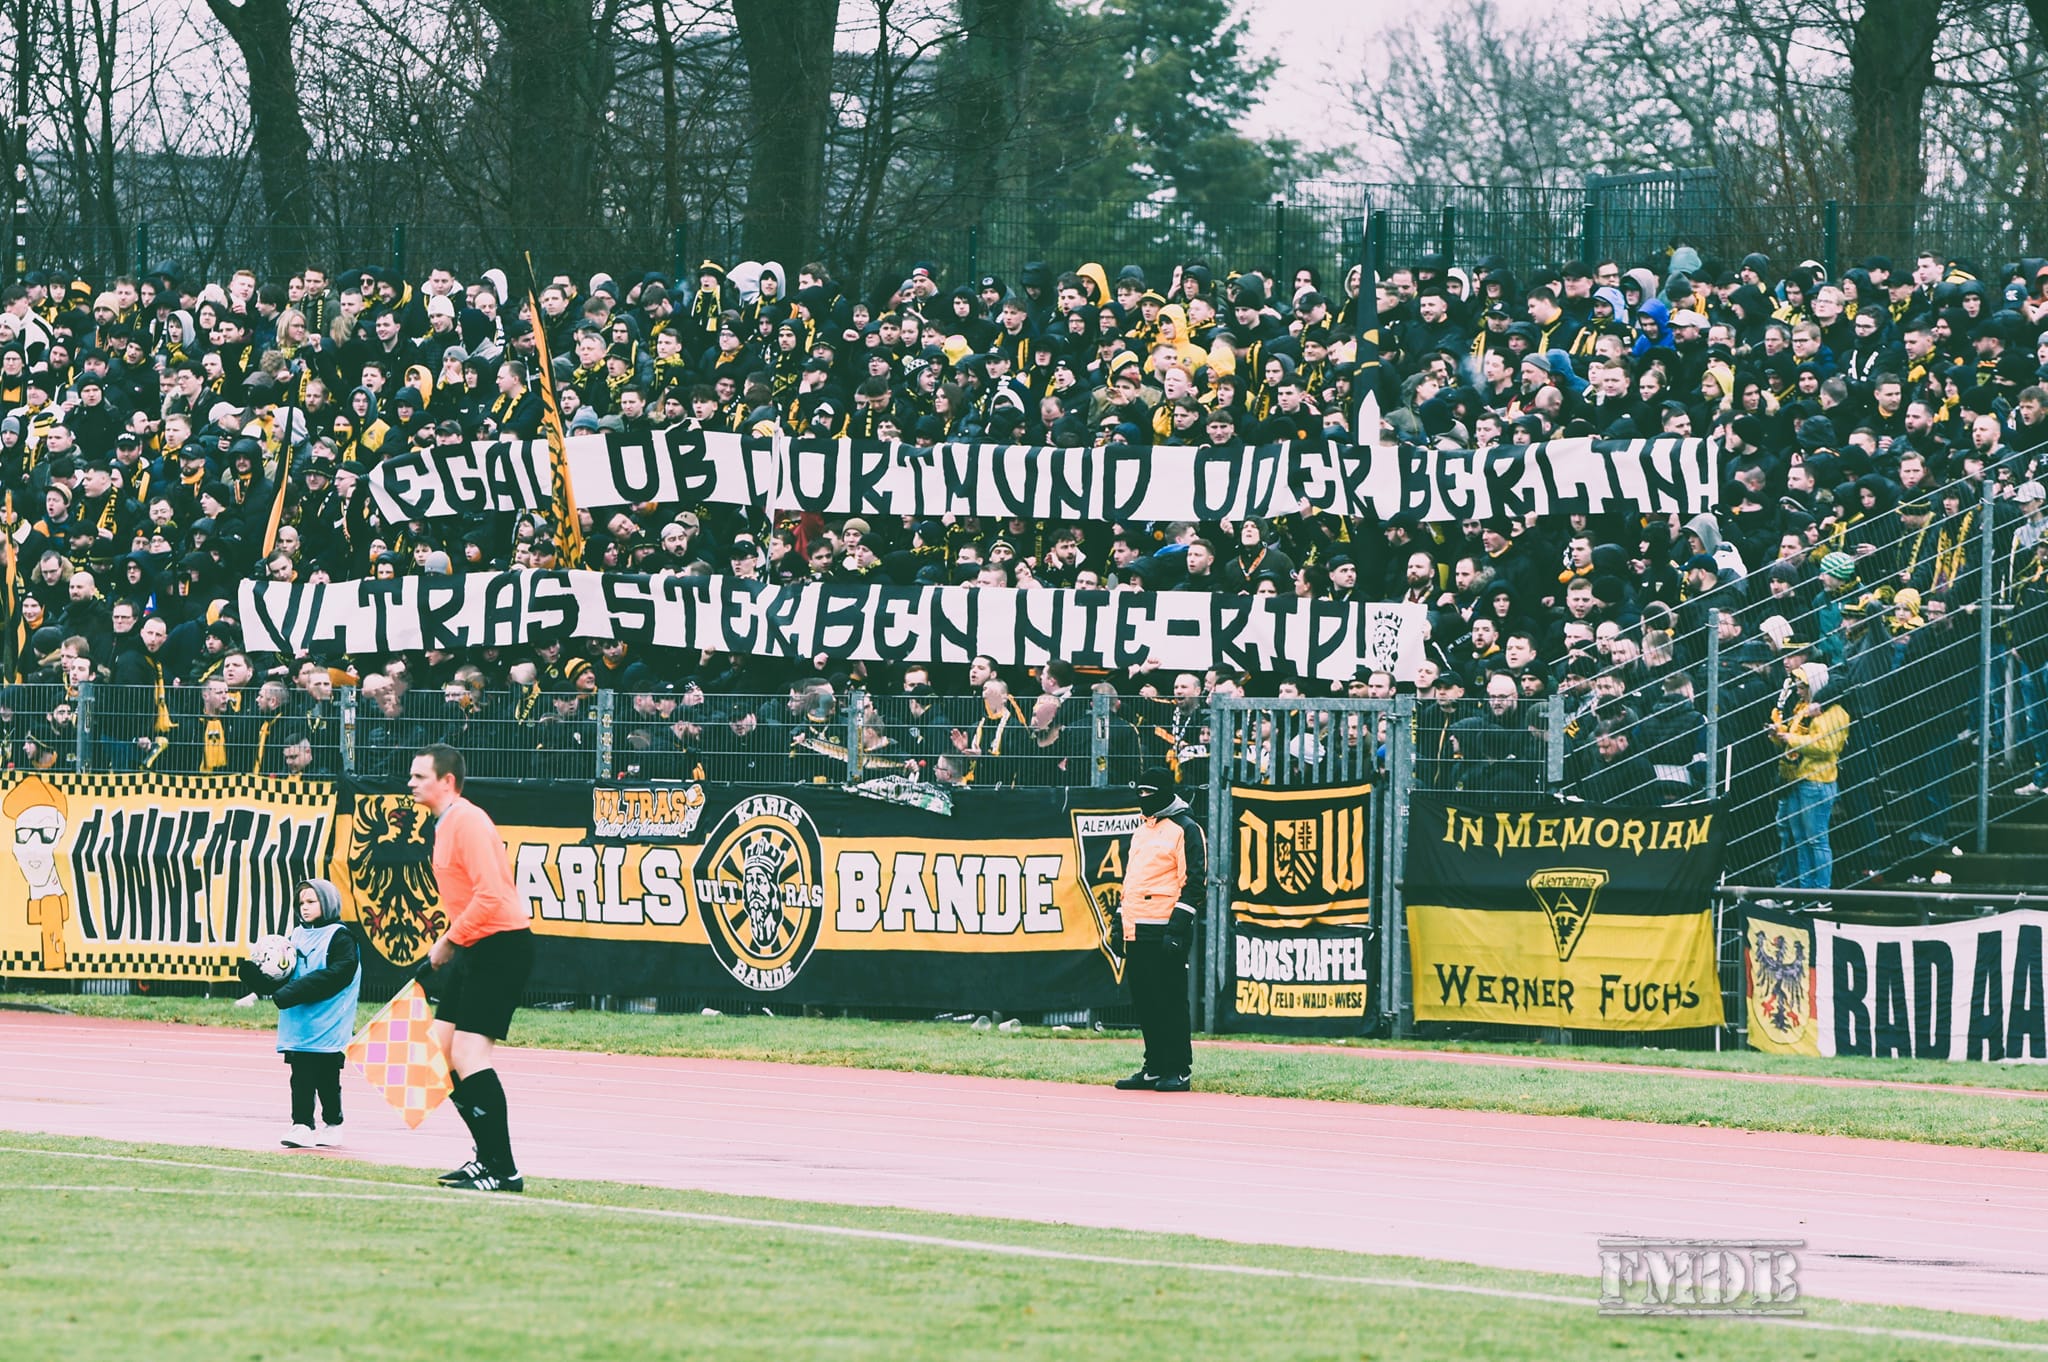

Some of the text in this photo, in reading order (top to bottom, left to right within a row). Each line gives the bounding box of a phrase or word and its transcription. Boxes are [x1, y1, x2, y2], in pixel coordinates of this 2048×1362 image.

[740, 434, 1153, 521] DORTMUND
[253, 567, 580, 656] ULTRAS
[601, 573, 979, 663] STERBEN
[594, 789, 687, 824] ULTRAS
[735, 796, 802, 826] KARLS
[1097, 839, 1123, 879] A
[503, 841, 1063, 934] ARLS BANDE
[1536, 874, 1597, 888] Alemannia
[1555, 891, 1578, 912] A
[733, 958, 794, 989] BANDE
[1236, 934, 1367, 982] BOXSTAFFEL
[1275, 992, 1294, 1009] FELD
[1303, 992, 1327, 1009] WALD
[1433, 963, 1574, 1014] WERNER
[1833, 935, 1954, 1059] BAD
